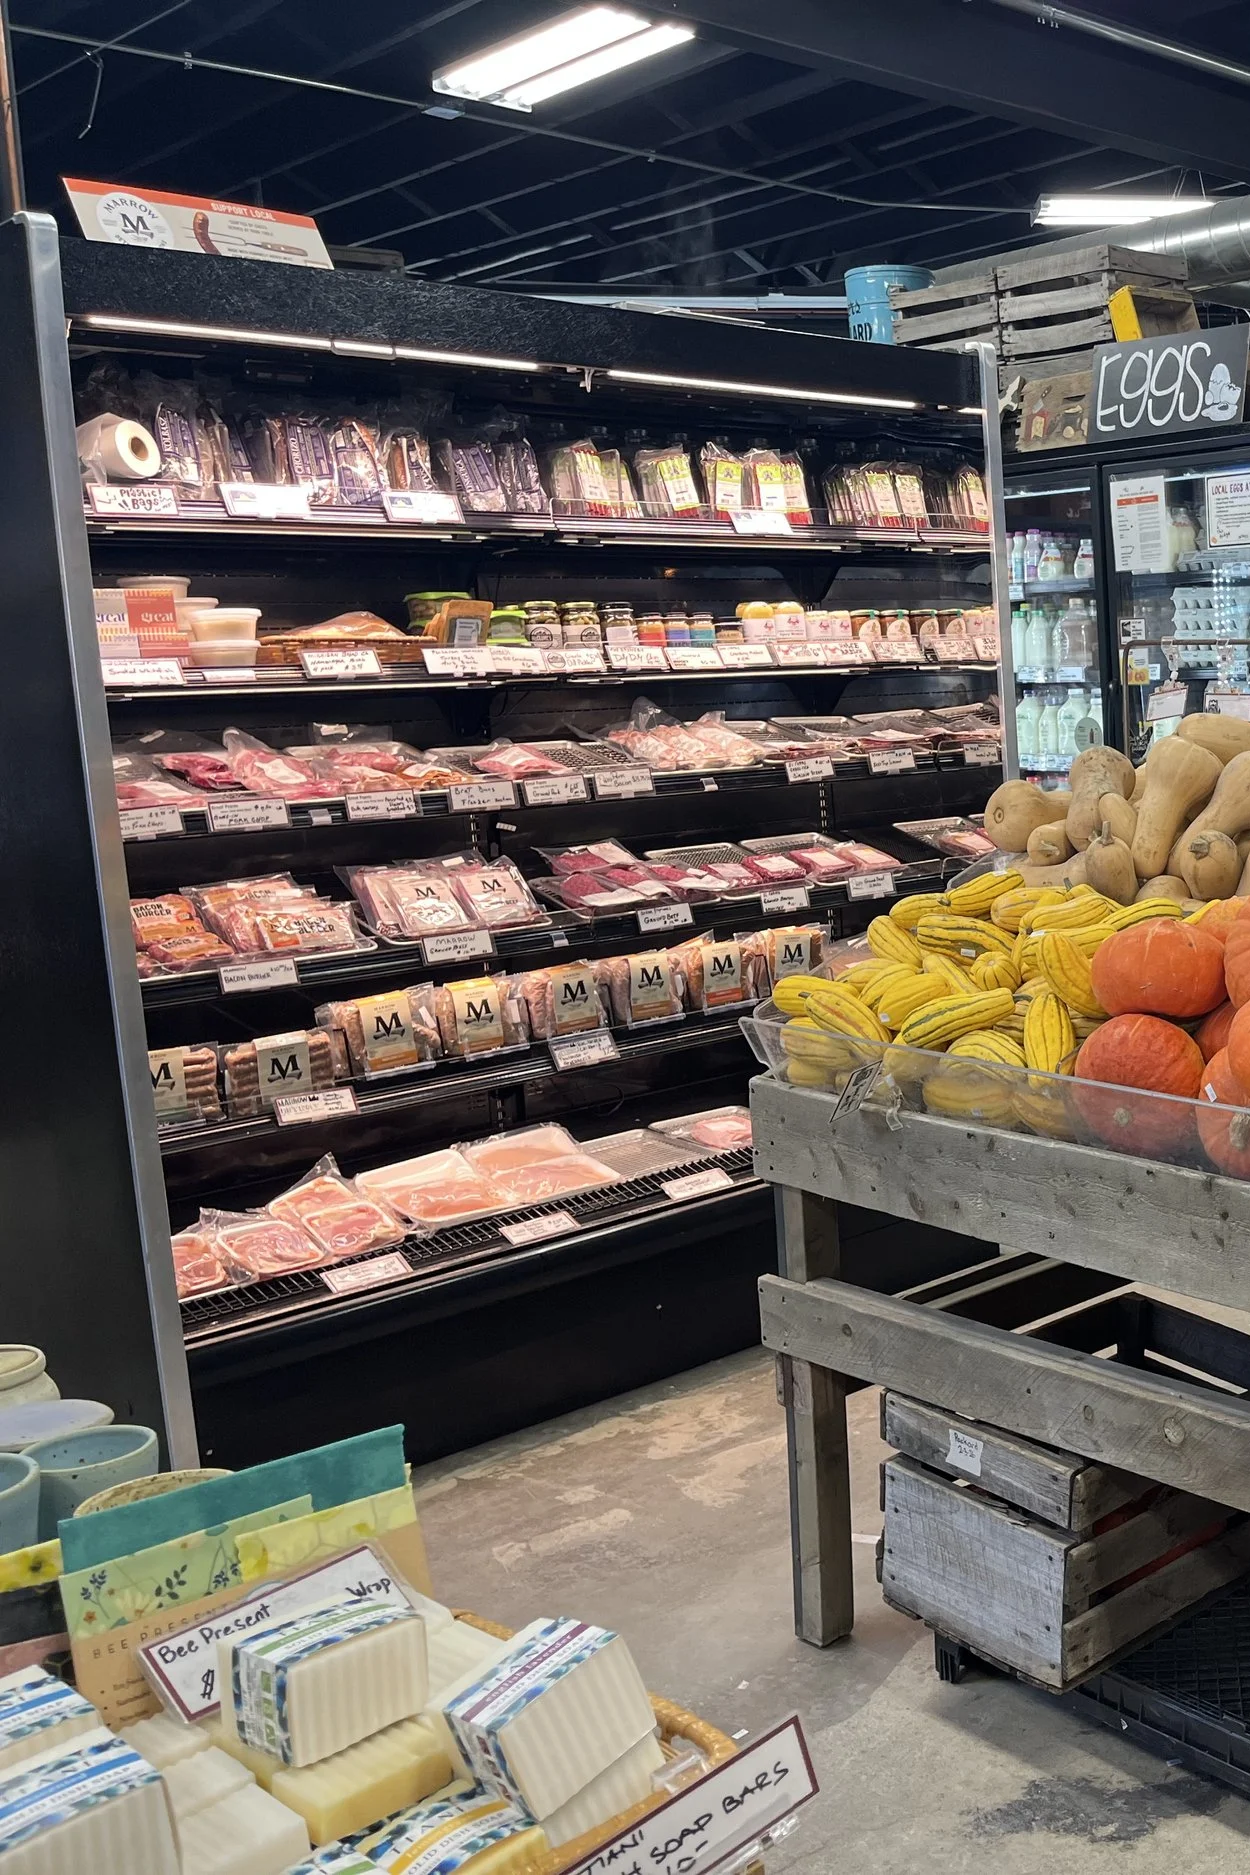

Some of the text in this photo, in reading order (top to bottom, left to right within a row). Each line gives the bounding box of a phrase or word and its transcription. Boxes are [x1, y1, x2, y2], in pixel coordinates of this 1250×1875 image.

[103, 198, 158, 220] MARROW
[211, 203, 276, 220] SUPPORT LOCAL
[120, 213, 150, 234] M
[290, 437, 301, 475] CHORIZO
[1211, 485, 1228, 495] LOCAL
[1230, 483, 1243, 493] EGGS
[141, 611, 174, 624] great
[133, 903, 163, 914] BACON
[135, 908, 173, 919] BURGER
[435, 934, 476, 946] MARROW
[712, 954, 733, 974] M
[784, 943, 803, 963] M
[640, 966, 663, 987] M
[563, 980, 587, 1003] M
[467, 999, 491, 1022] M
[375, 1012, 403, 1037] M
[270, 1054, 301, 1080] M
[345, 1576, 392, 1600] Wrap
[157, 1602, 273, 1665] Bee Present
[92, 1638, 130, 1660] BEE
[485, 1632, 573, 1704] english lavender
[94, 1766, 132, 1786] SOAP
[649, 1761, 790, 1865] SOAP BARS
[407, 1810, 505, 1875] OLID DISH SOAP
